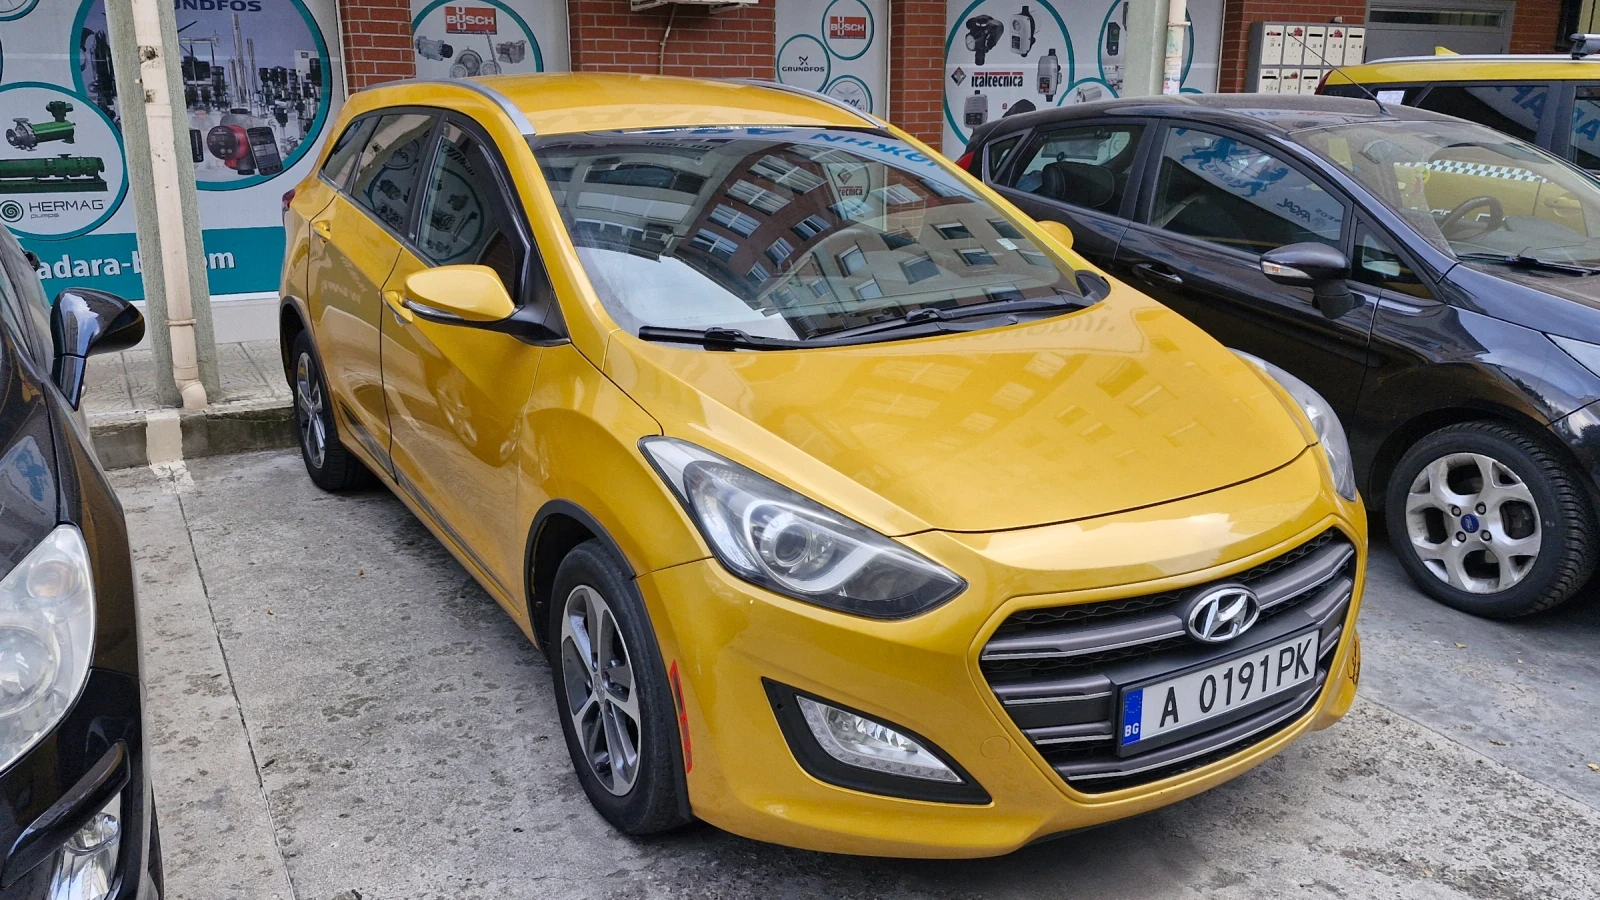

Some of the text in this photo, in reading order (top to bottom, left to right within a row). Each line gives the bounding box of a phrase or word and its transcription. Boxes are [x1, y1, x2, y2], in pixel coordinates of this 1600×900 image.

[174, 0, 262, 12] NDFOS
[446, 14, 495, 25] BUSCH
[830, 23, 865, 32] BUSCH
[971, 72, 1024, 88] italtecnica
[29, 199, 104, 212] HERMAG
[1159, 686, 1179, 728] A
[1124, 722, 1140, 737] BG
